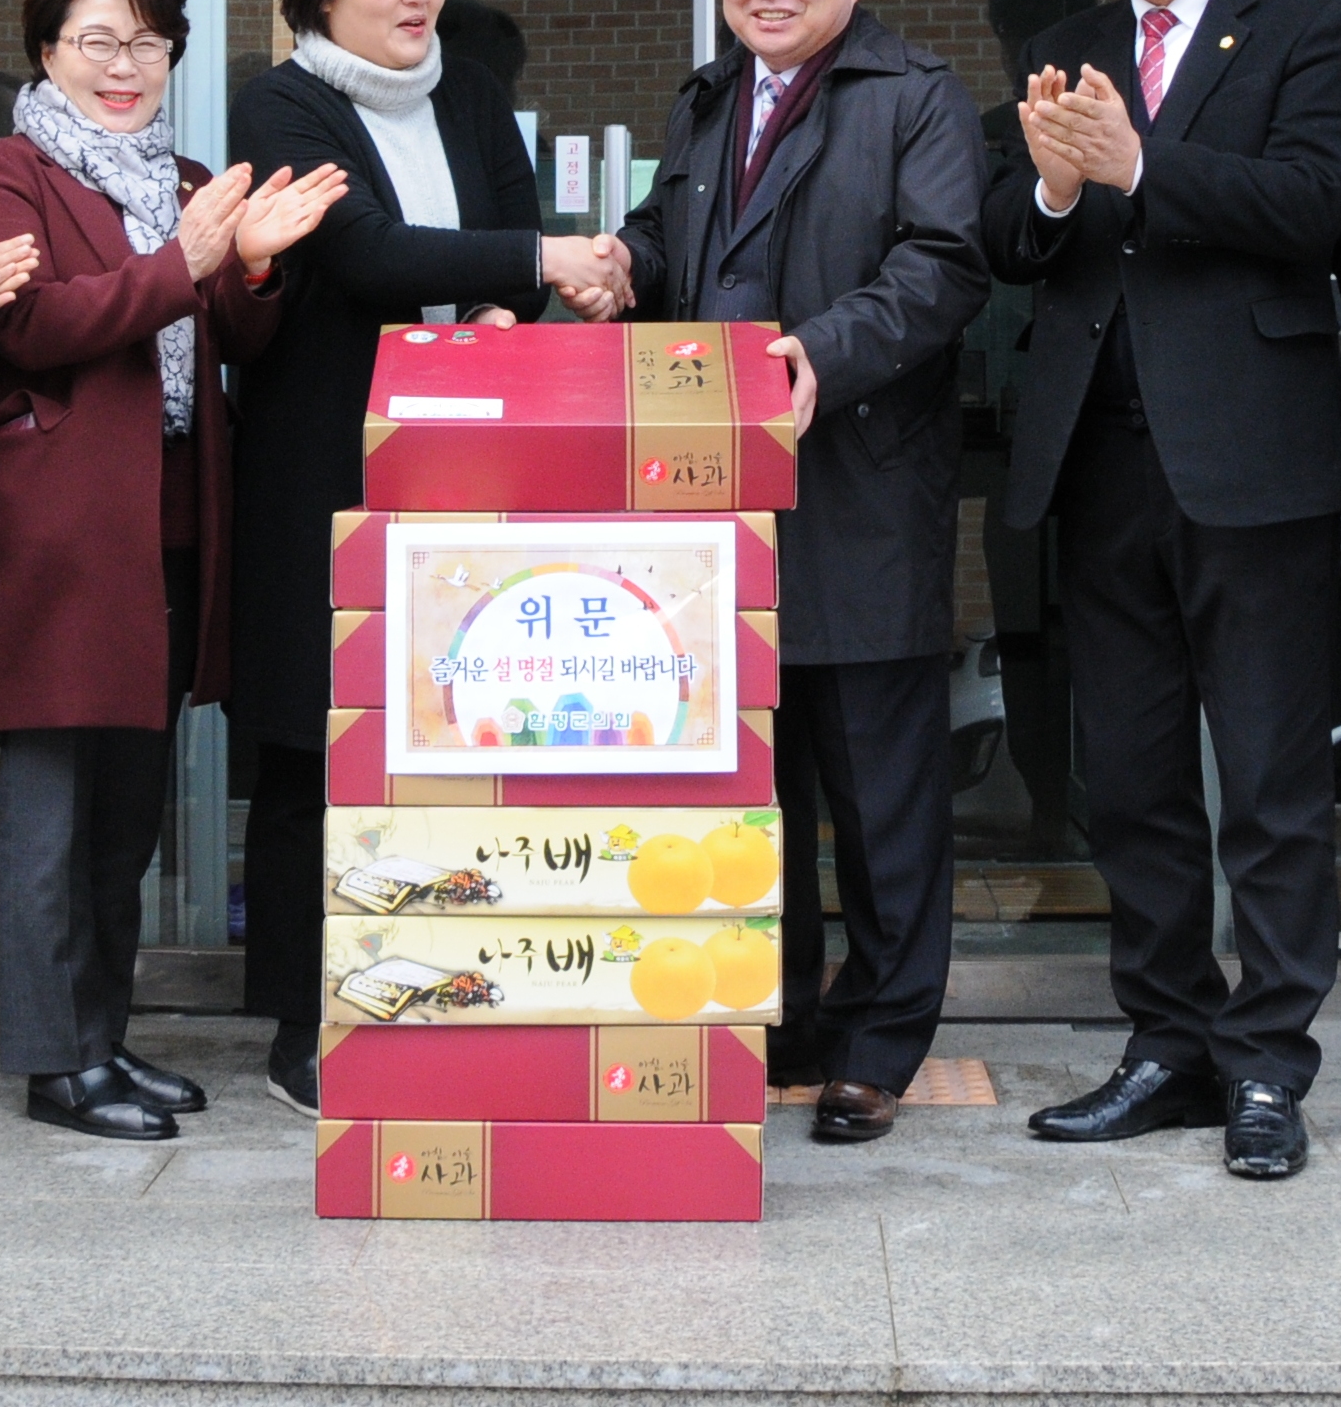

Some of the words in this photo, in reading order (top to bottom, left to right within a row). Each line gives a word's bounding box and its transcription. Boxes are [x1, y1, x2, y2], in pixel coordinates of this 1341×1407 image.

[566, 143, 579, 194] 고정문
[668, 359, 713, 390] 사과
[672, 465, 727, 487] 사과
[431, 656, 490, 684] 즐거운
[492, 656, 513, 683] 설
[517, 656, 554, 683] 명절
[560, 655, 616, 683] 되시길
[620, 654, 697, 682] 바랍니다
[529, 712, 630, 729] 함평군의회
[638, 1072, 695, 1096] 사과
[421, 1161, 478, 1185] 사과
